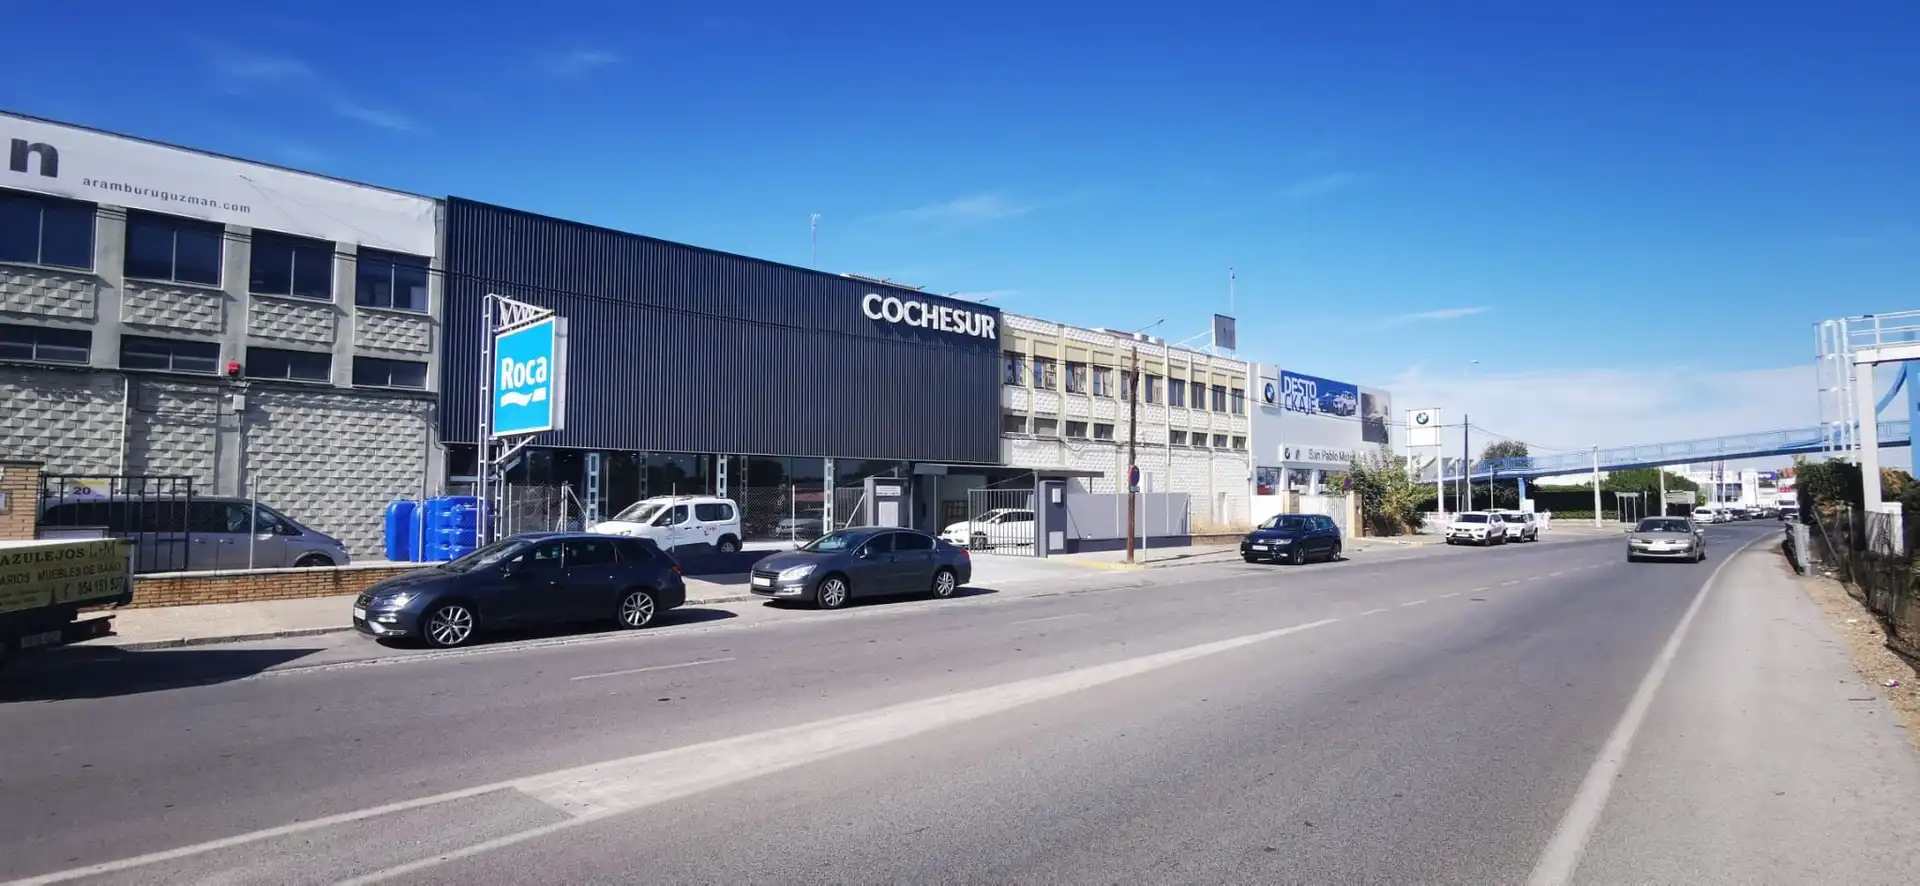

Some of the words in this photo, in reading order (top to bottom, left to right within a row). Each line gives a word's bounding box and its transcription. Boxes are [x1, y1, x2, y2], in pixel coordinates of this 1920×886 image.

[82, 175, 252, 214] aramburuguzman.com
[861, 292, 997, 340] COCHESUR
[500, 355, 548, 391] Roca
[1283, 375, 1317, 399] DESTO
[72, 486, 91, 496] 20
[0, 548, 85, 566] AZULEJOS
[37, 566, 81, 582] MUEBLES
[83, 564, 96, 576] DE
